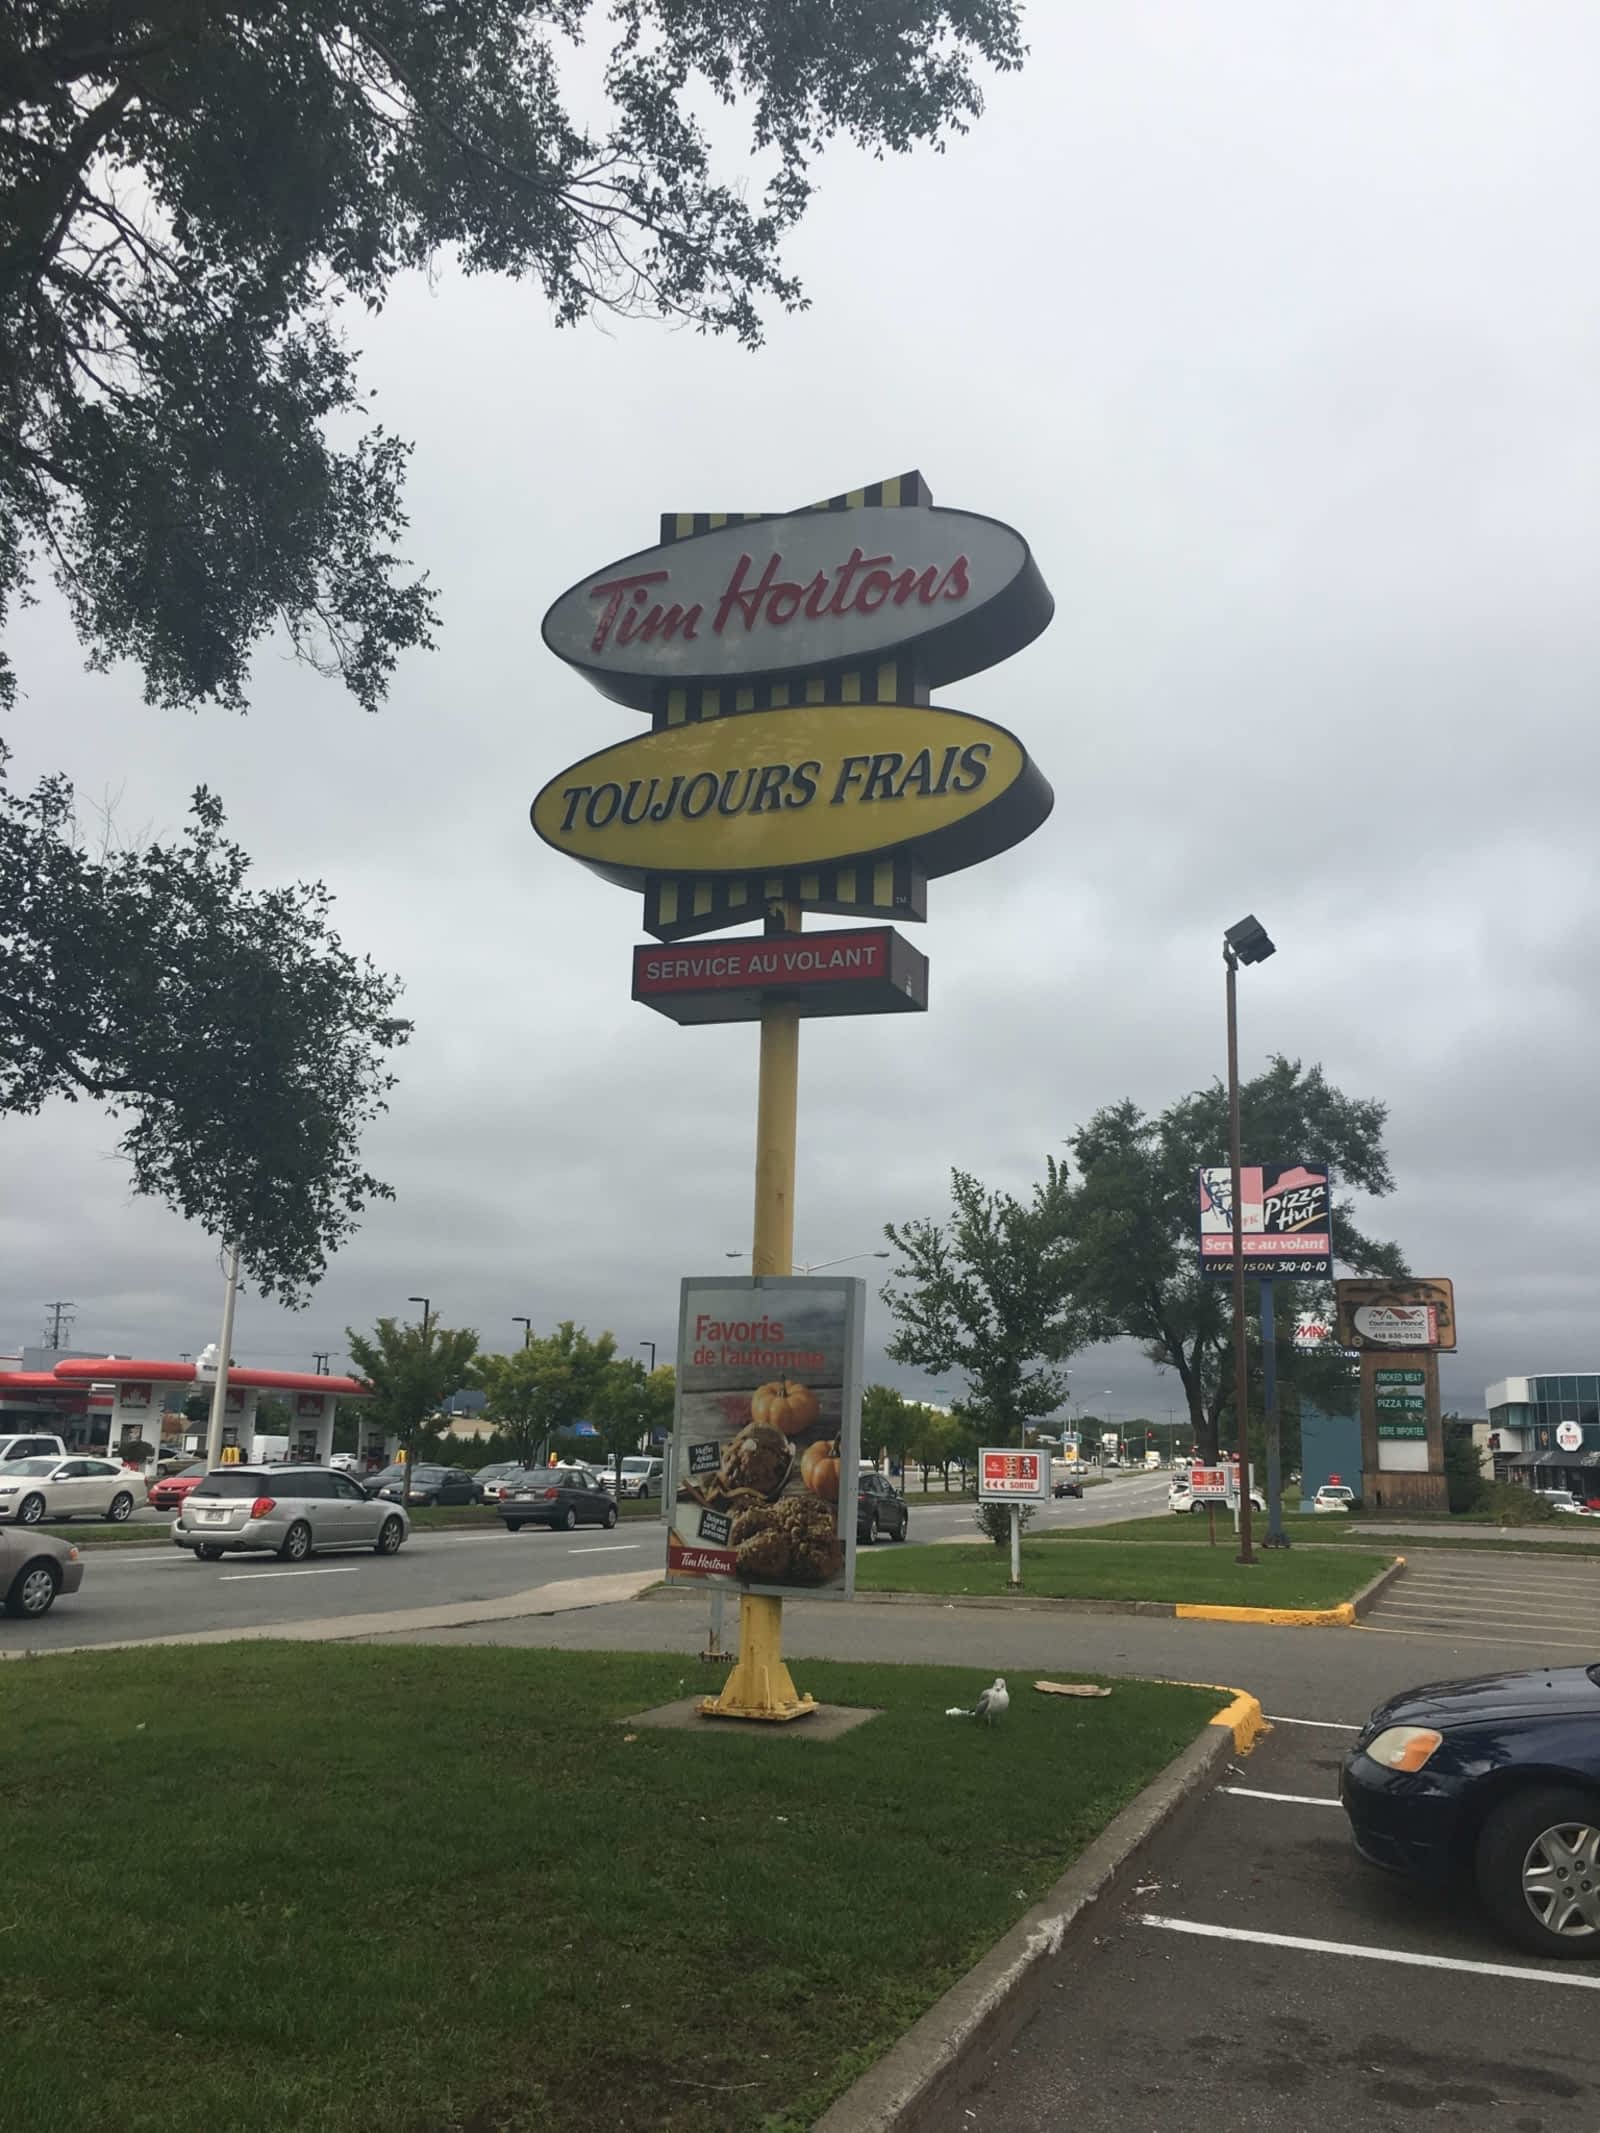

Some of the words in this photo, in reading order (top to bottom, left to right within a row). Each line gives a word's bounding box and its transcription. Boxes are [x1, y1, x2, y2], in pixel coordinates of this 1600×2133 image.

[590, 570, 704, 653] Tim
[713, 547, 970, 634] Hortons
[560, 760, 822, 831] TOUJOURS
[830, 742, 993, 807] FRAIS
[646, 956, 742, 980] SERVICE
[747, 954, 778, 974] AU
[783, 946, 878, 971] VOLANT
[1264, 1186, 1326, 1226] Pizza
[1276, 1201, 1321, 1231] Hut
[1204, 1238, 1256, 1251] Servce
[1258, 1241, 1277, 1250] au
[1279, 1238, 1325, 1250] volant
[1205, 1262, 1275, 1272] LIVRISON
[1276, 1261, 1328, 1273] 310-10-10
[695, 1314, 785, 1342] Favoris
[693, 1346, 715, 1366] de
[1377, 1400, 1402, 1408] PIZZA
[1404, 1400, 1423, 1409] FINE
[1009, 1481, 1035, 1489] SORTIE
[681, 1552, 697, 1567] Tim
[698, 1552, 731, 1571] Hortons
